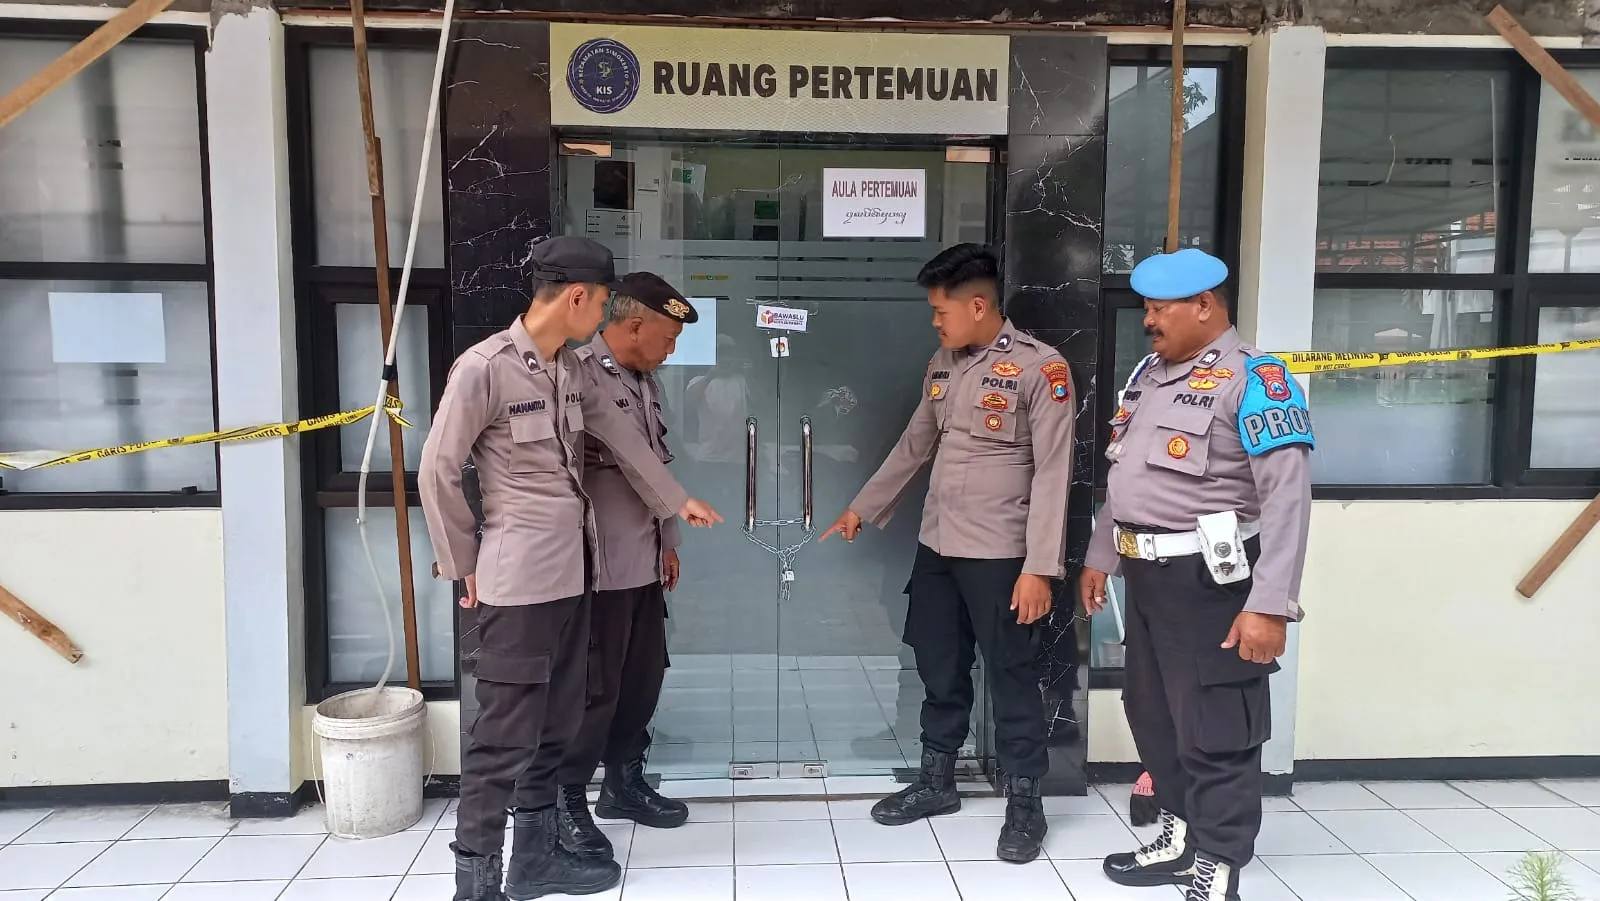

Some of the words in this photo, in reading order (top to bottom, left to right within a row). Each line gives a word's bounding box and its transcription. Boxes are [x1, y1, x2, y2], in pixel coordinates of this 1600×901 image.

[653, 60, 778, 98] RUANG
[789, 65, 998, 101] PERTEMUAN
[596, 86, 613, 95] KIS
[832, 180, 857, 198] AULA
[861, 180, 918, 198] PERTEMUAN
[774, 313, 805, 321] BAWASLU
[1292, 352, 1333, 363] DILARANG
[981, 377, 1018, 391] POLRI
[1173, 393, 1215, 408] POLRI
